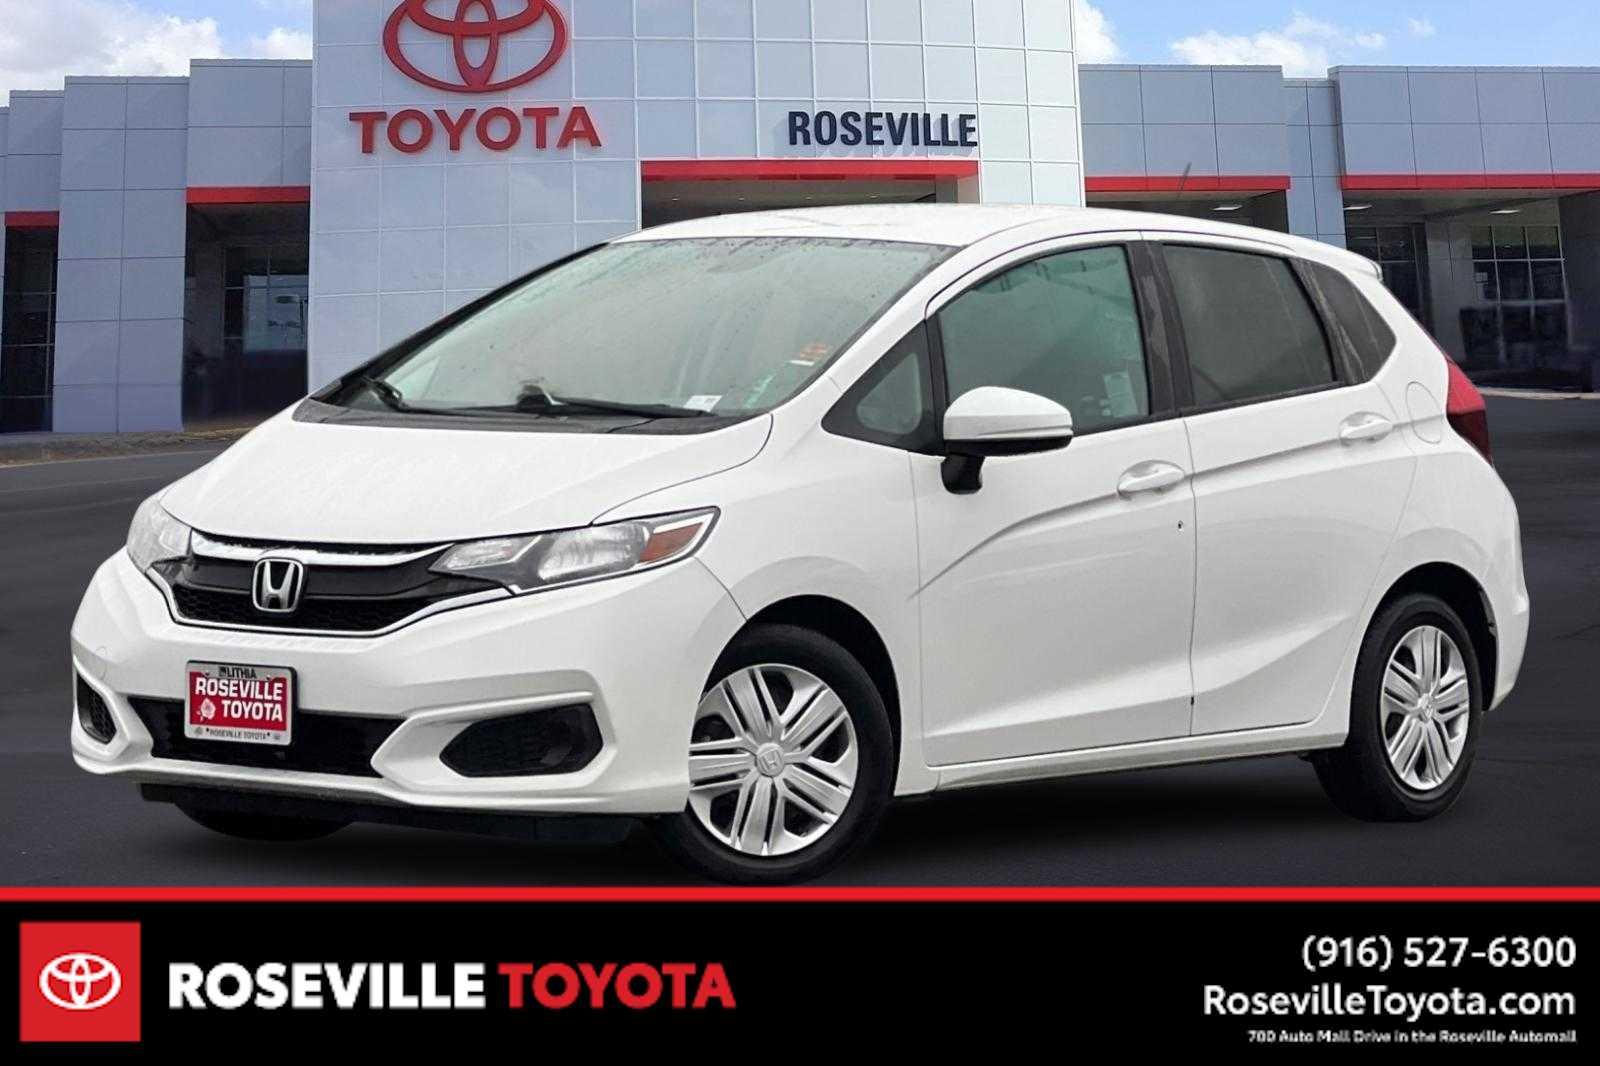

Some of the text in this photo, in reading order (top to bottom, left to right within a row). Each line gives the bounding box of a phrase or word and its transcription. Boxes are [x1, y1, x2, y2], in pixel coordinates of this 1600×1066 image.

[349, 105, 602, 154] TOYOTA
[788, 111, 978, 147] ROSEVILLE
[226, 666, 257, 679] LITHIA
[194, 677, 283, 701] ROSEVILLE
[221, 699, 283, 722] TOYOTA
